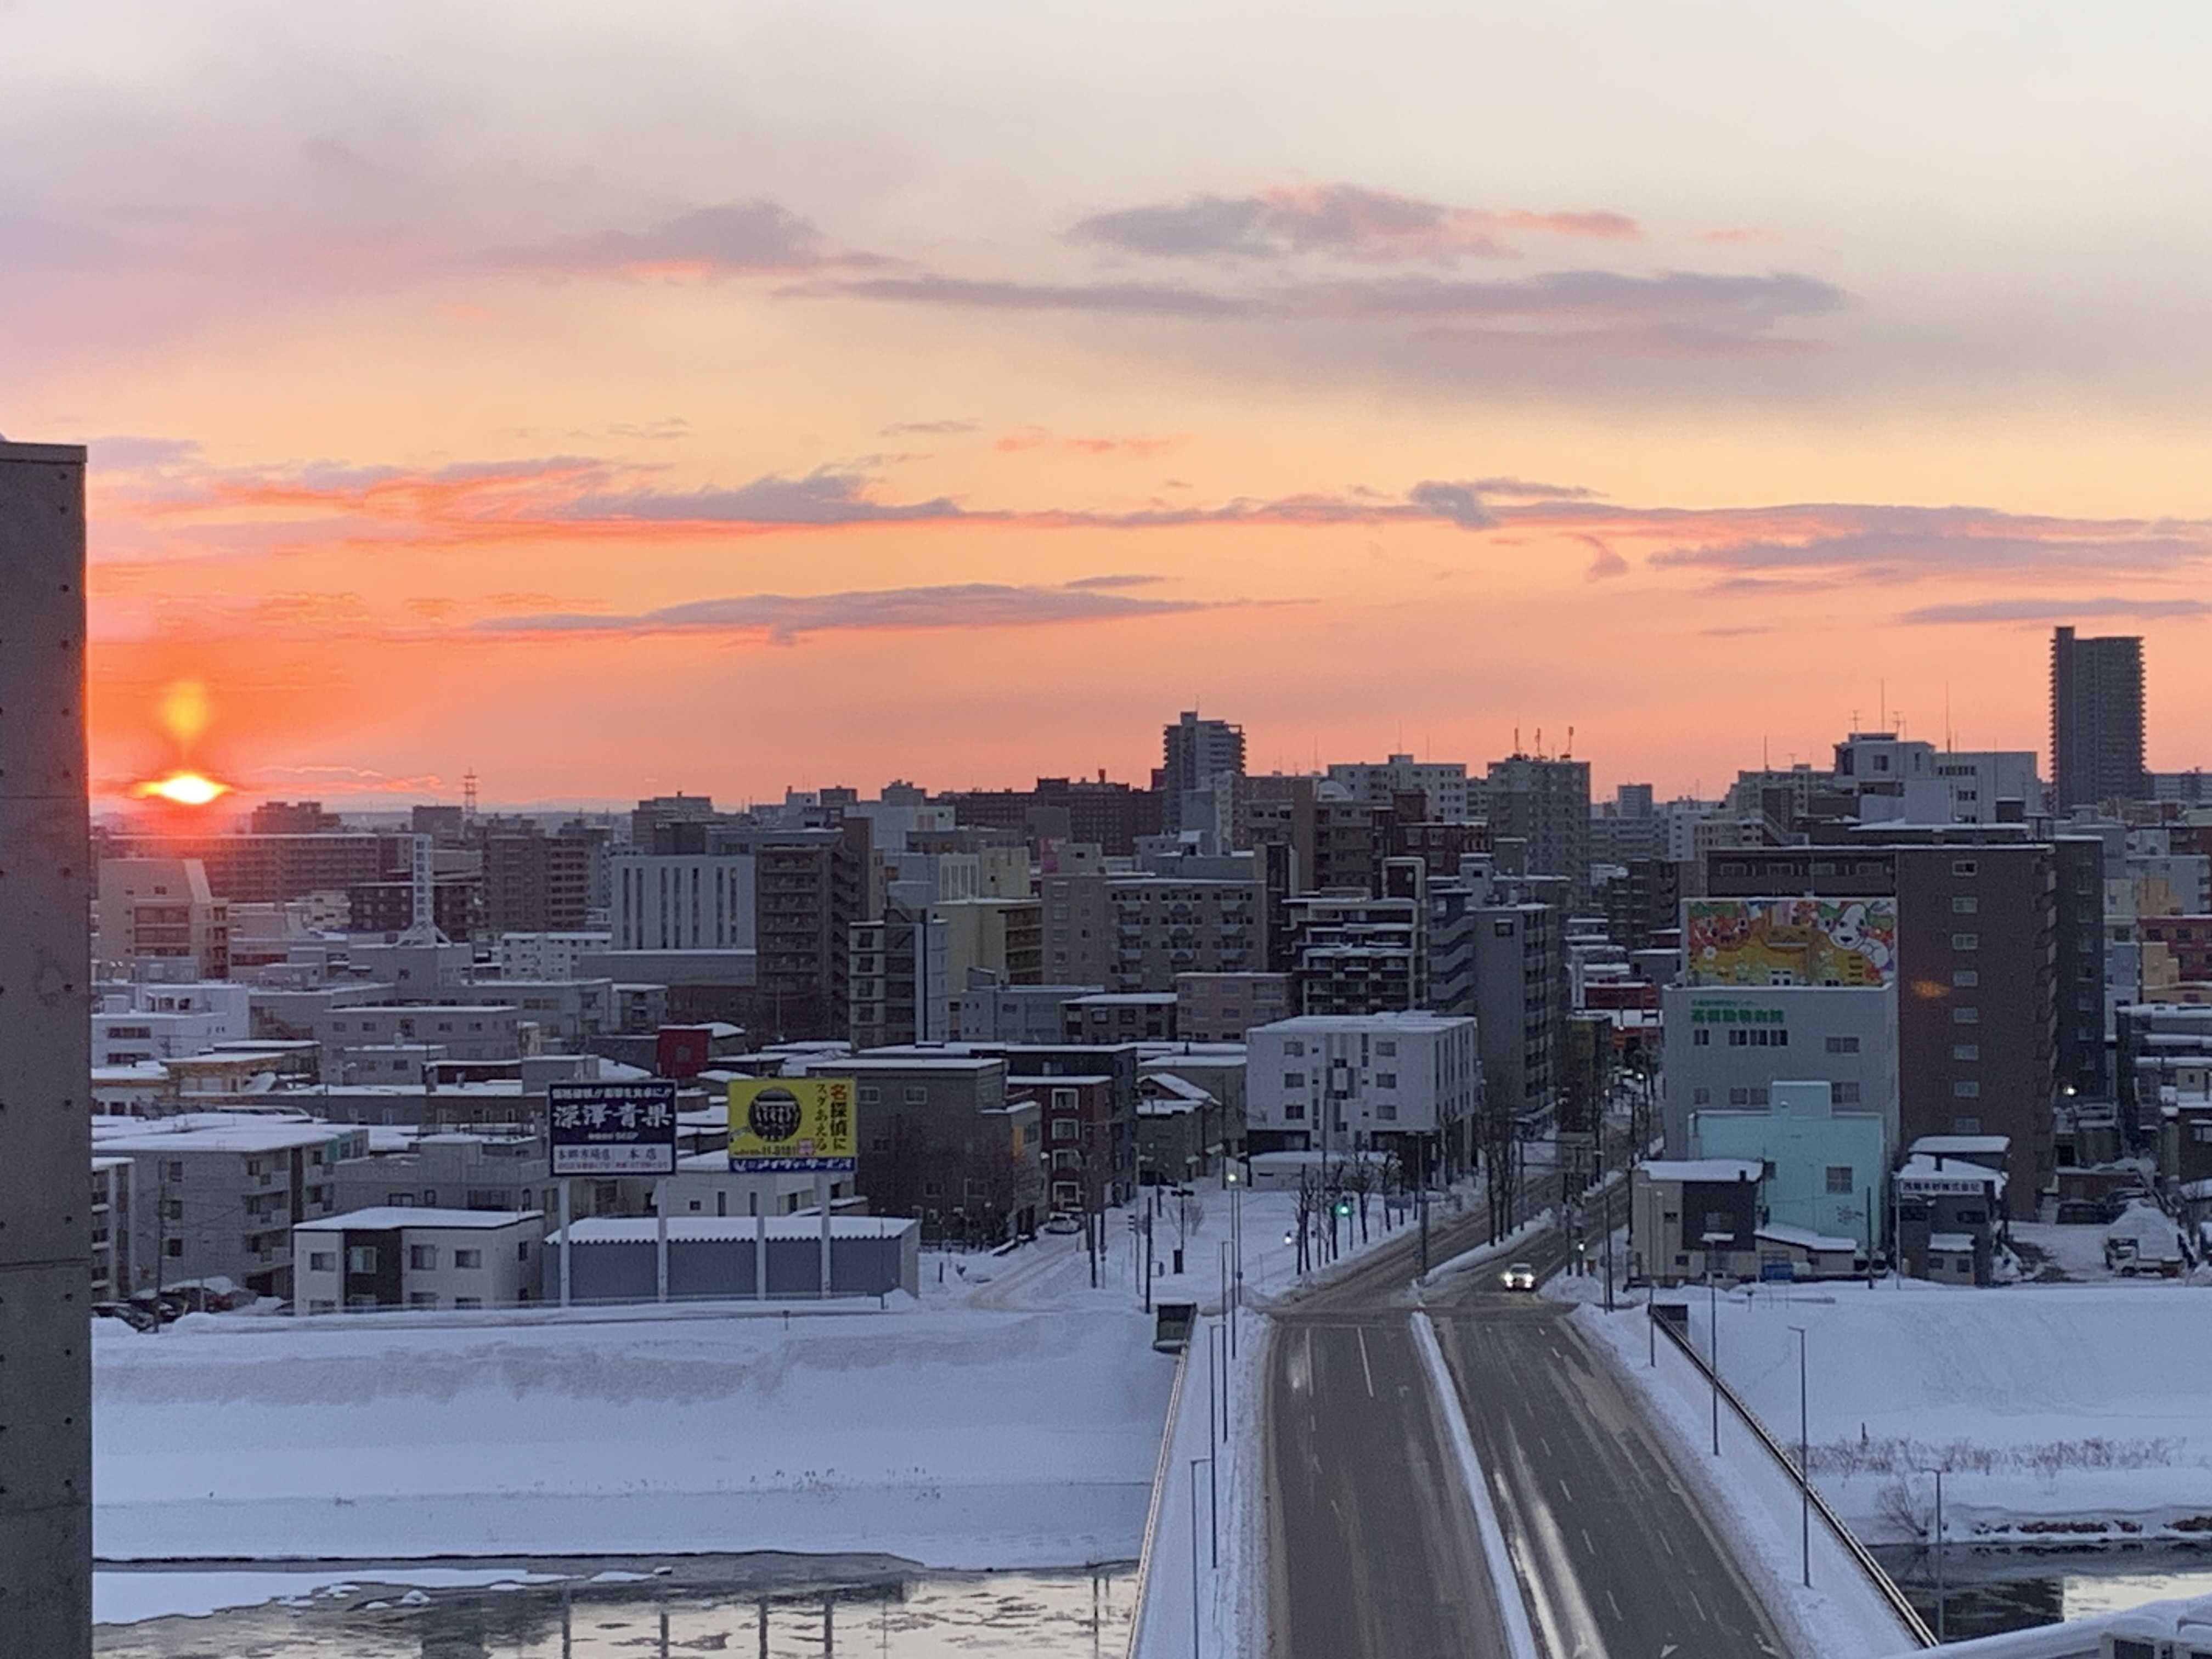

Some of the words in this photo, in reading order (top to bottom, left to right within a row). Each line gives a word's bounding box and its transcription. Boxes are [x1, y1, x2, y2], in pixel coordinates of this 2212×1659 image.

[552, 1102, 674, 1129] 深澤青果
[815, 1084, 828, 1152] スグあえる
[830, 1084, 848, 1150] 名探偵に
